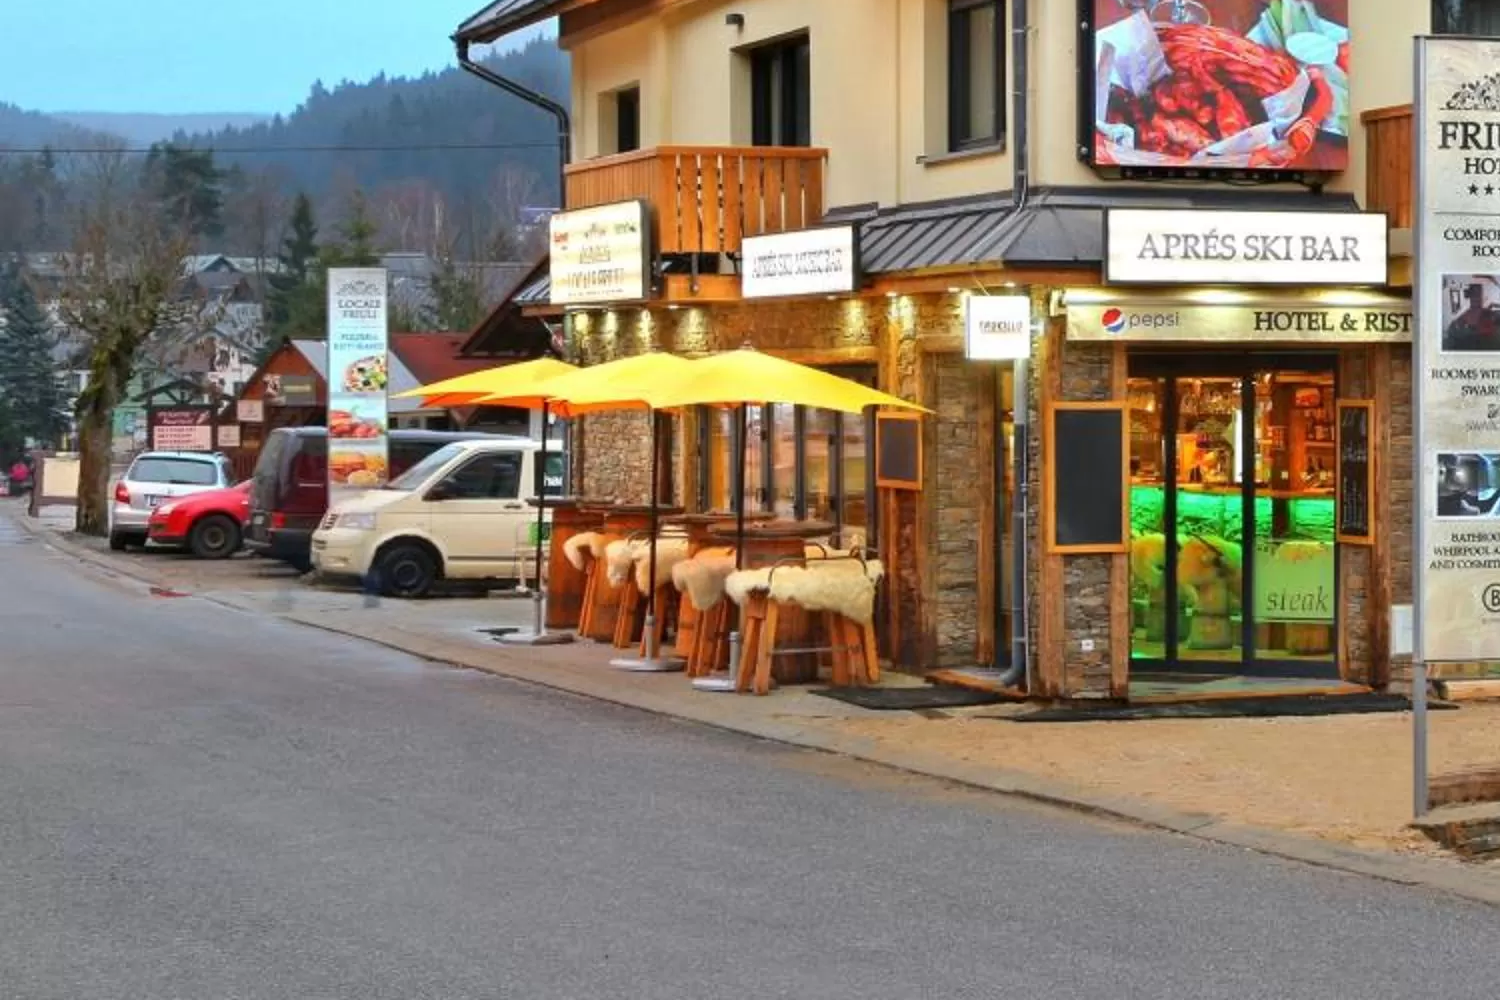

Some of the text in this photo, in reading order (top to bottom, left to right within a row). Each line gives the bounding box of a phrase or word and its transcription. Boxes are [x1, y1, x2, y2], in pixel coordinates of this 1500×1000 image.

[1137, 228, 1360, 262] APRÉS SKI BAR
[1129, 312, 1180, 330] pepsi
[1253, 311, 1335, 331] HOTEL
[1339, 312, 1358, 331] &
